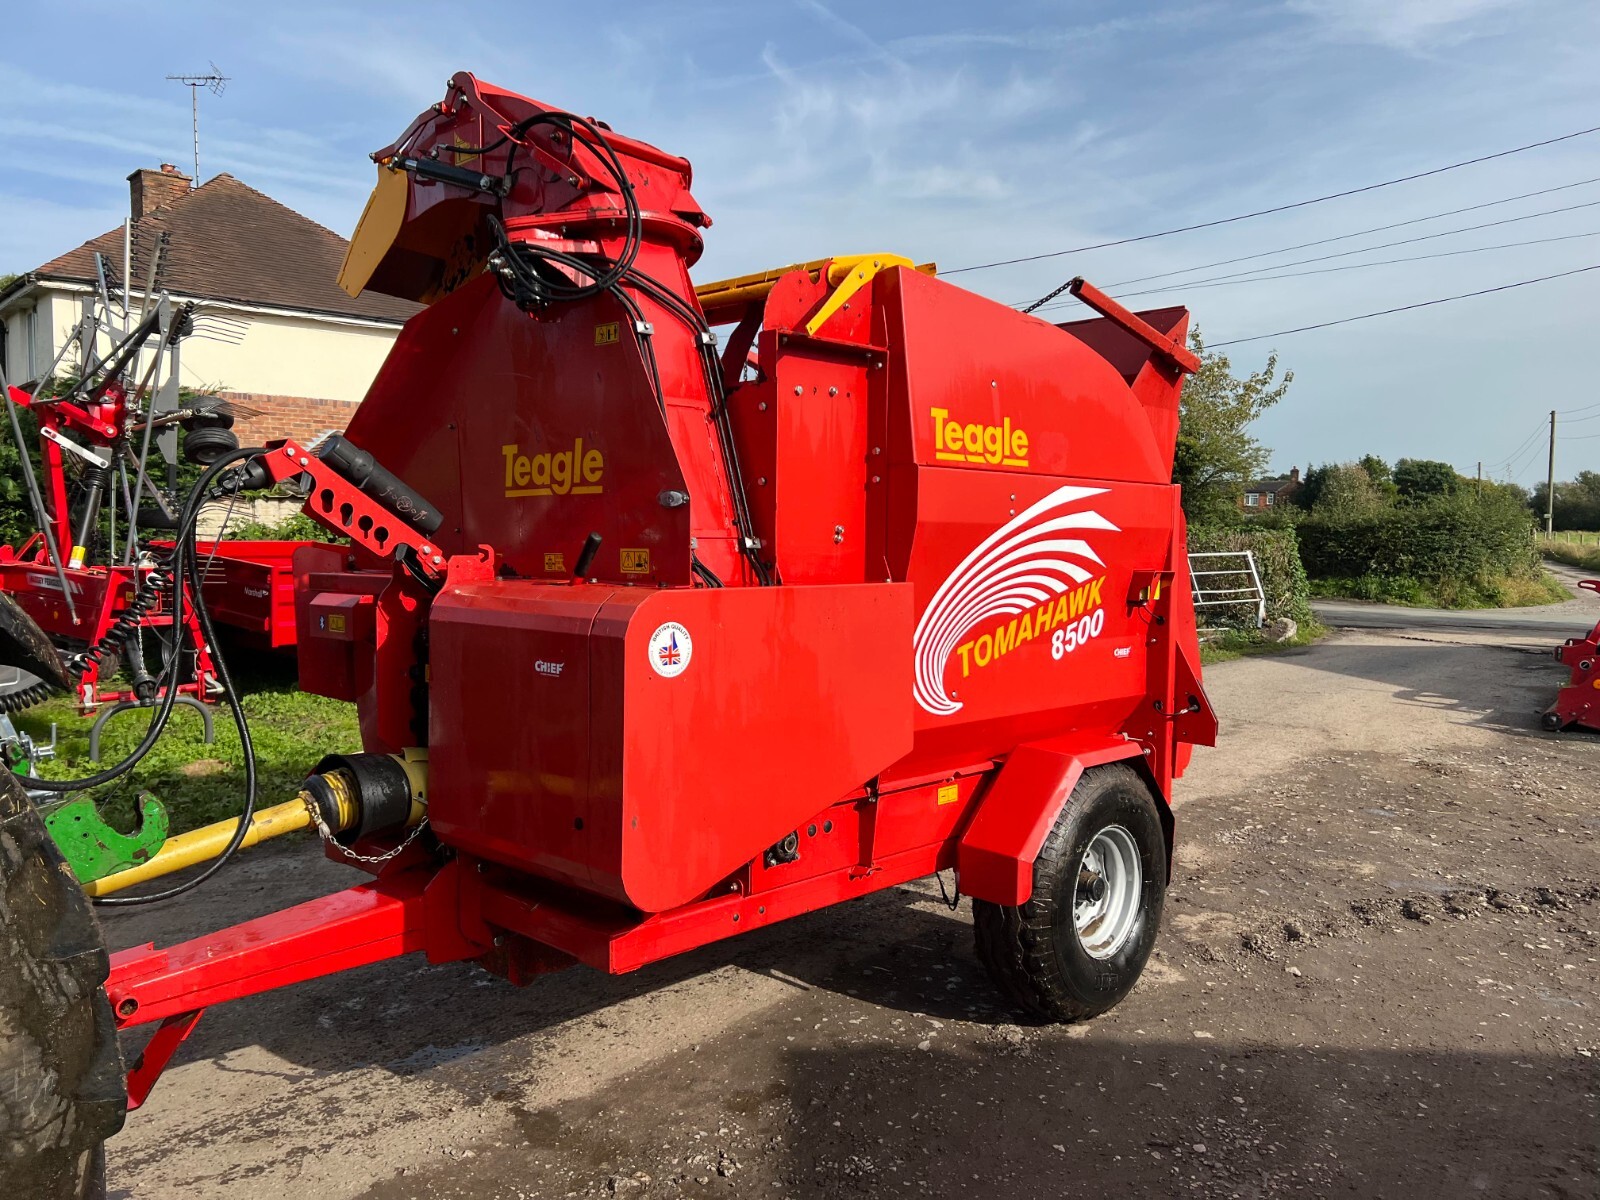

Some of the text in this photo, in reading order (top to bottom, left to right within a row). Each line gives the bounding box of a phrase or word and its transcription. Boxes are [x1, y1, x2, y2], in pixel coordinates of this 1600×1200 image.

[930, 406, 1029, 465] Teagle
[502, 437, 604, 496] Teagle
[652, 624, 689, 642] BRITISH QUALITY
[956, 575, 1107, 679] TOMAHAWK
[1052, 608, 1104, 661] 8500
[1114, 646, 1131, 657] CHIEF
[534, 659, 564, 675] CHIEF
